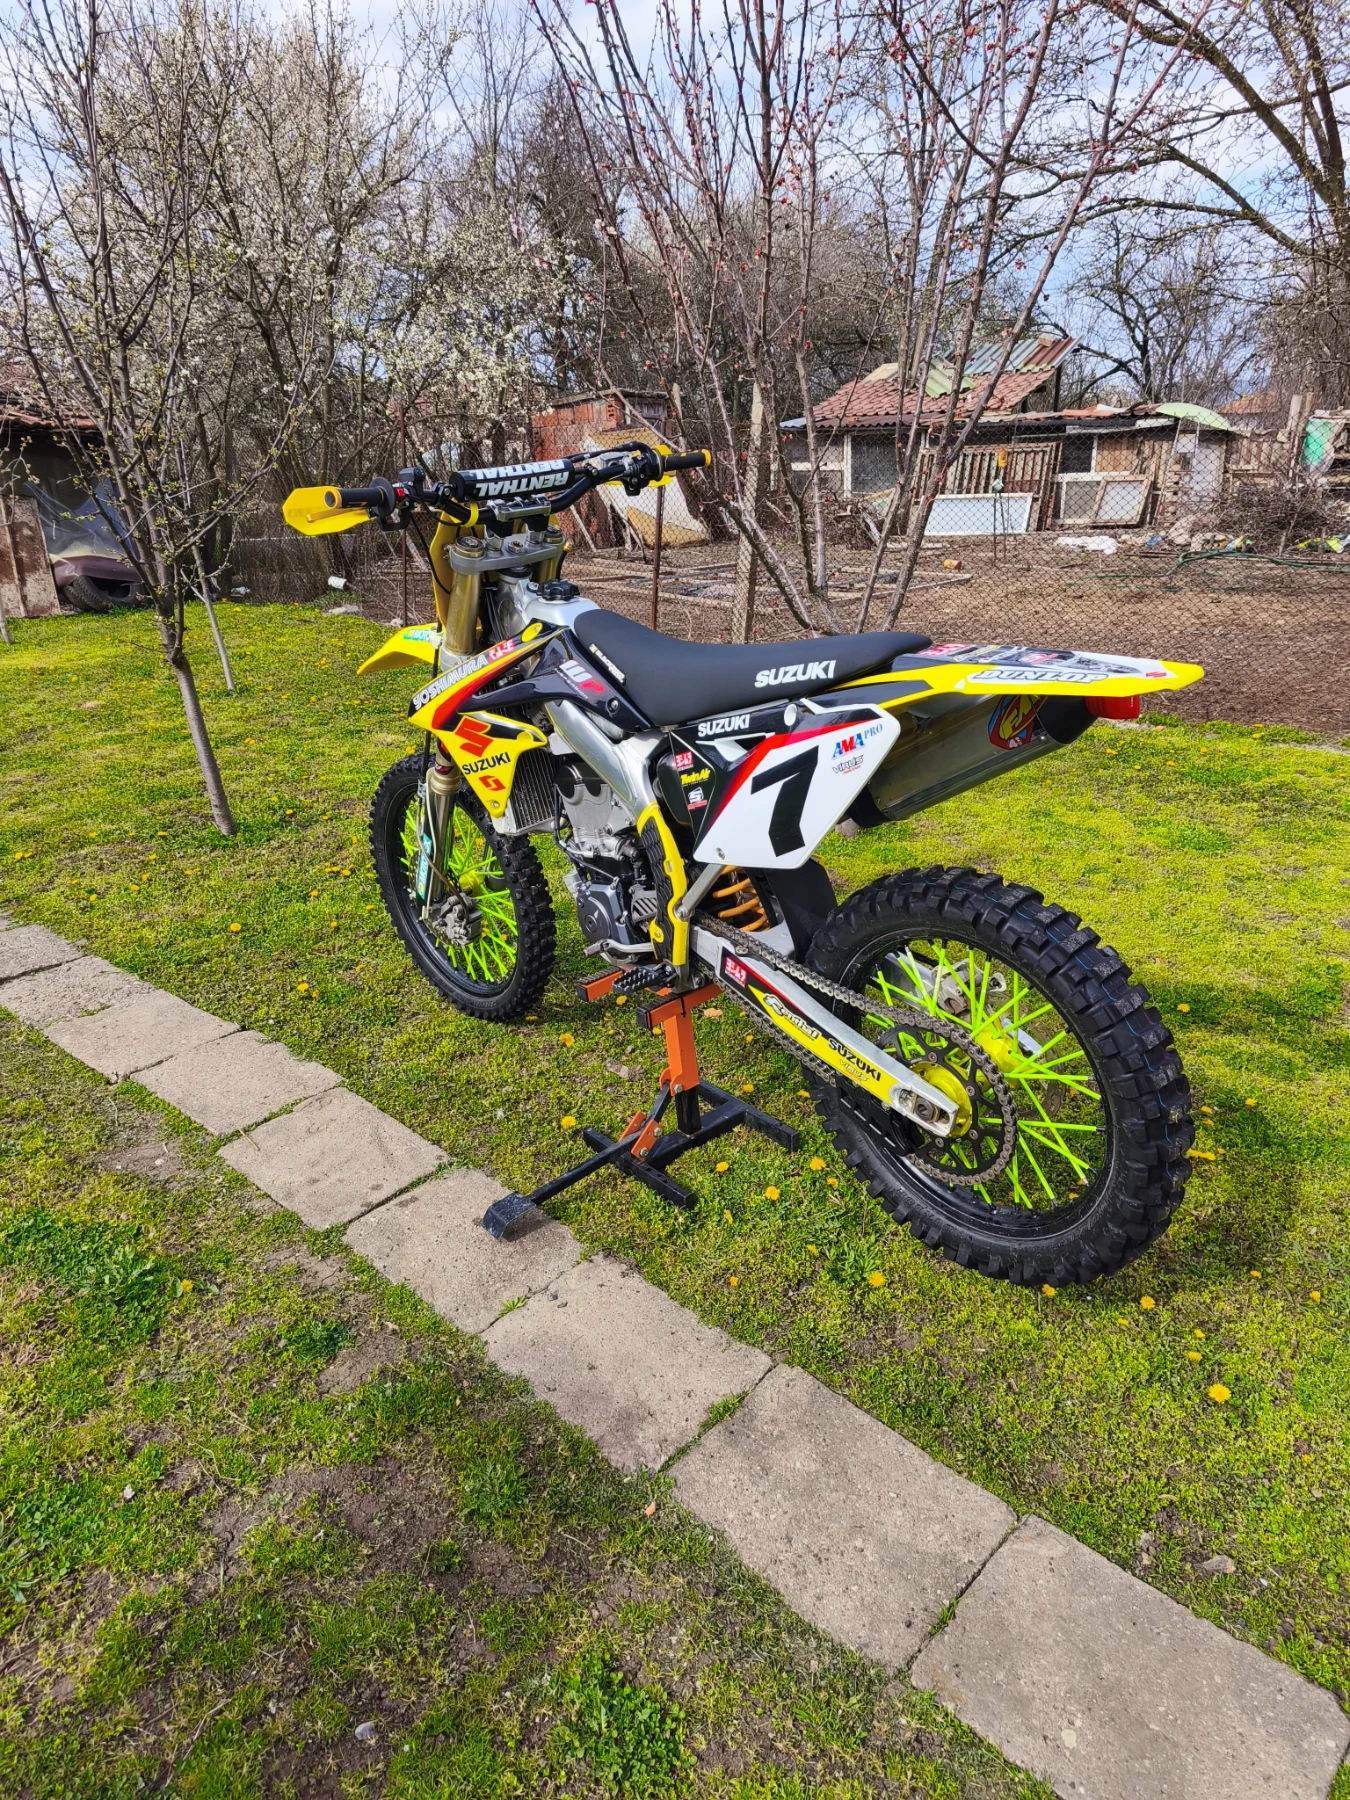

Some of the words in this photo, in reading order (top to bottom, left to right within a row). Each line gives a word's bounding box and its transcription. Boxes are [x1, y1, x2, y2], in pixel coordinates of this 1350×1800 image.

[476, 472, 569, 497] RENTHAL
[412, 655, 489, 710] YOSHIMURA
[754, 660, 837, 688] SUZUKI
[974, 669, 1109, 683] DUNLOP
[698, 714, 751, 738] SUZUKI
[832, 732, 866, 759] AMA
[864, 723, 883, 740] PRO
[462, 752, 511, 775] SUZUKI
[832, 754, 864, 774] VIRUS
[751, 745, 819, 857] 7
[828, 1038, 882, 1081] SUZUKI
